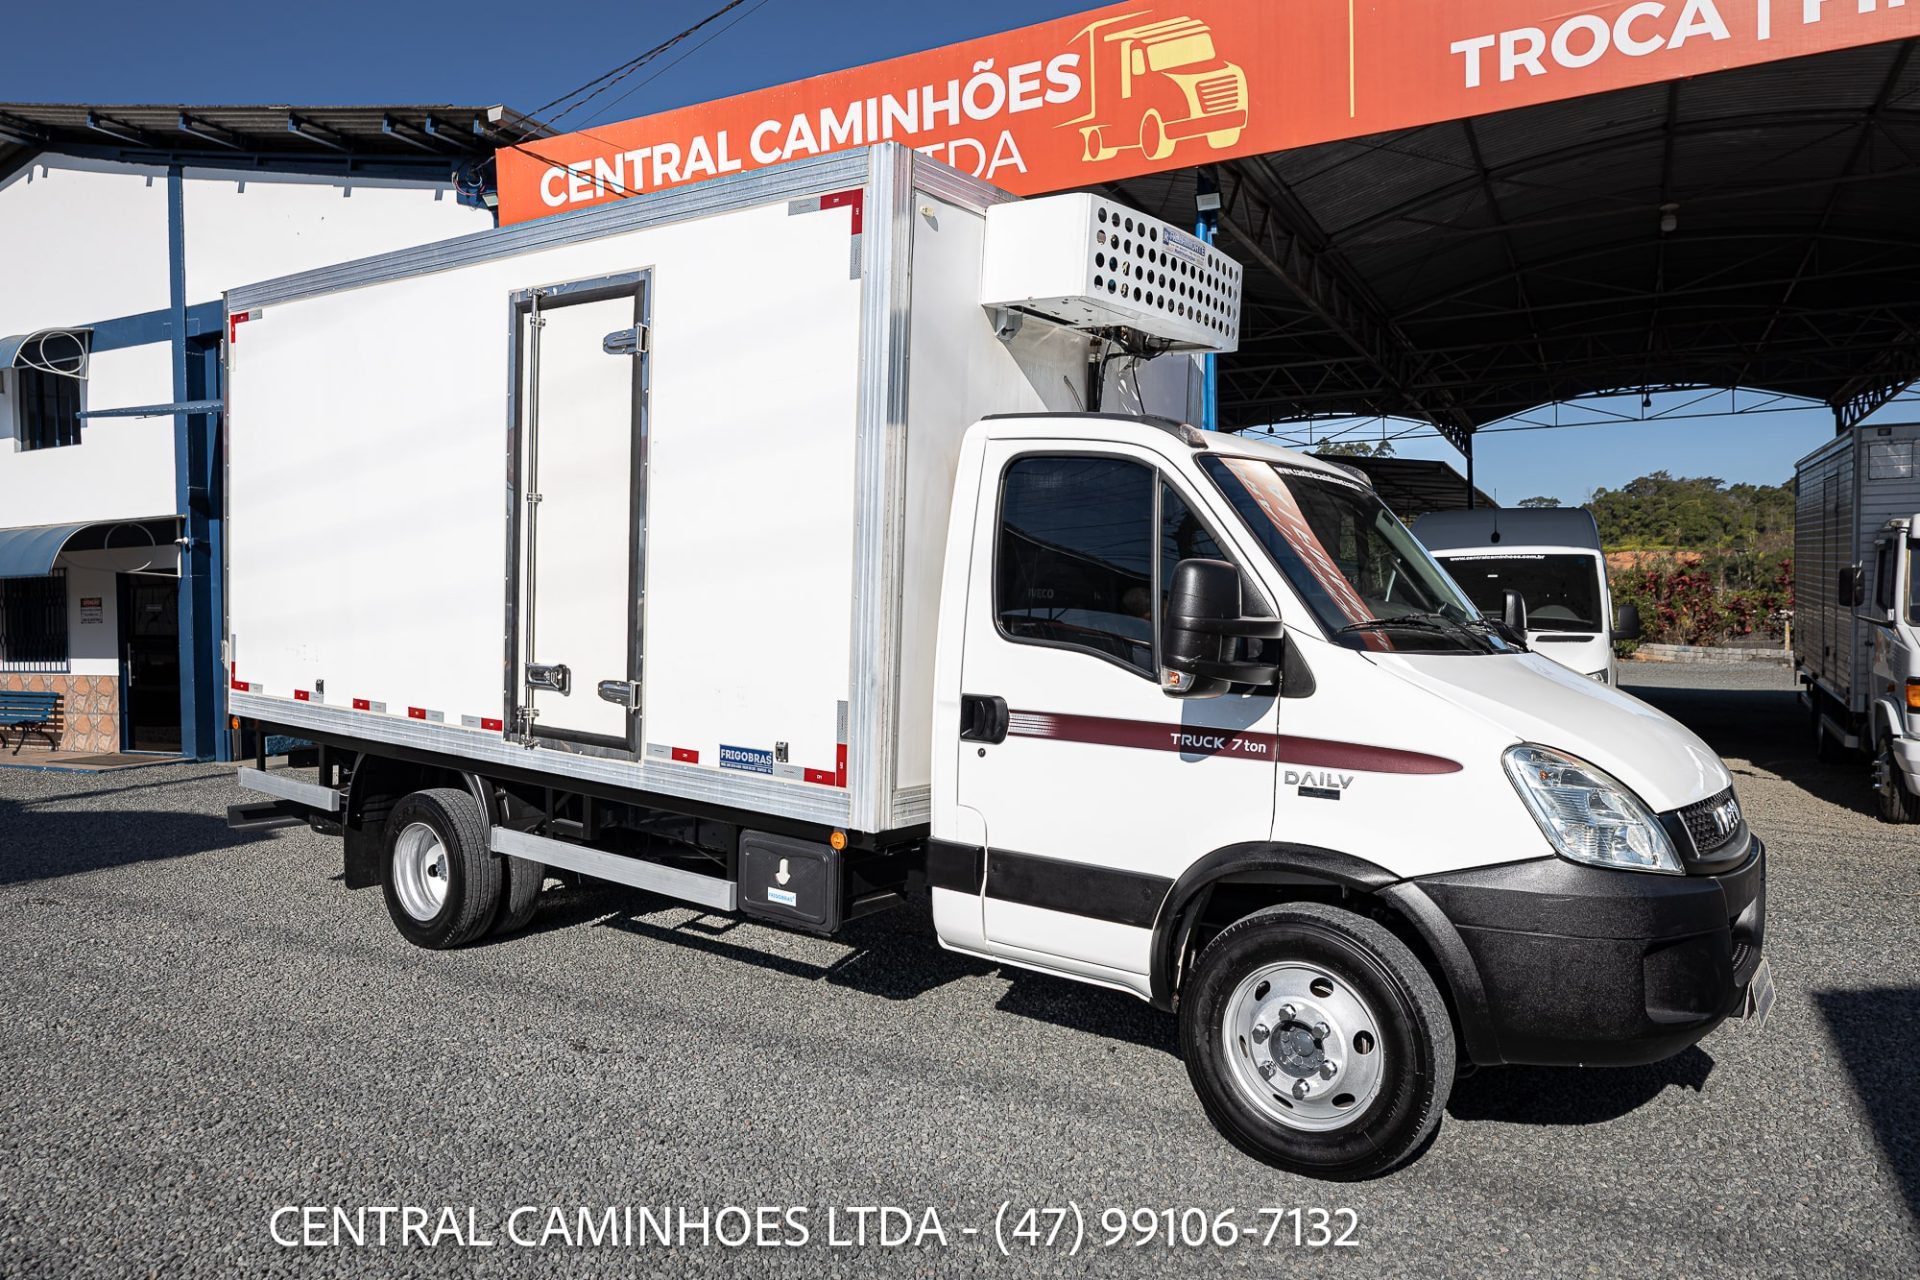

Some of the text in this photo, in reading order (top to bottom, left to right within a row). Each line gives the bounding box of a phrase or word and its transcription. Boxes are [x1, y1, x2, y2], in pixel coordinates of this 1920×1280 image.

[1450, 0, 1731, 88] TROCA
[540, 53, 1081, 207] CENTRAL CAMINHÕES
[1170, 733, 1267, 753] TRUCK 7 ton
[720, 749, 772, 765] FRIGOBRAS
[1284, 770, 1354, 789] DAILY
